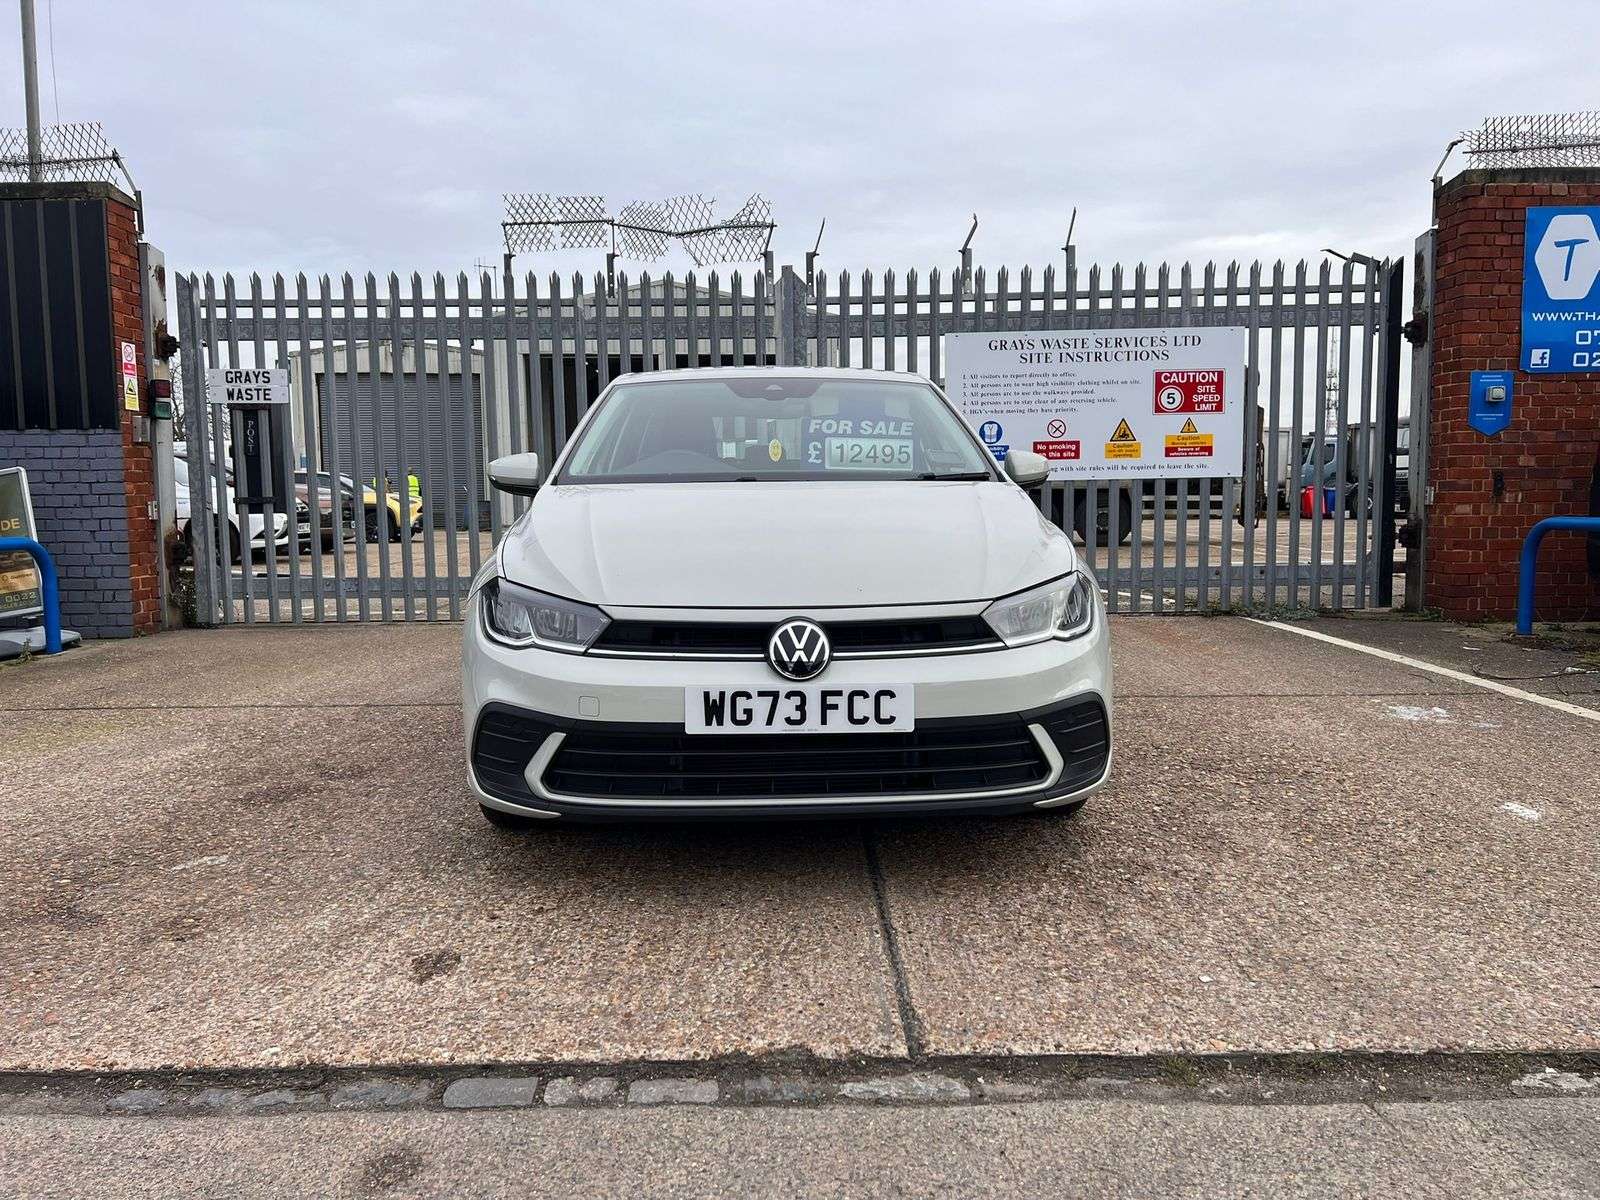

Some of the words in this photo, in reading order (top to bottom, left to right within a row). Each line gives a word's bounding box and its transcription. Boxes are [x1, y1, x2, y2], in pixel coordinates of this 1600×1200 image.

[1554, 238, 1589, 282] T
[1041, 337, 1090, 350] WASTE
[1094, 336, 1168, 349] SERVICES
[1173, 335, 1202, 347] LTD
[1019, 352, 1053, 364] SITE
[1059, 350, 1170, 363] INSTRUCTIONS
[225, 371, 271, 384] GRAYS
[1161, 372, 1218, 383] CAUTION
[226, 388, 272, 401] WASTE
[1197, 385, 1216, 393] SITE
[1166, 392, 1176, 405] 5
[1192, 394, 1221, 402] SPEED
[1195, 403, 1217, 411] LIMIT
[808, 419, 853, 434] FOR
[859, 421, 914, 436] SALE
[808, 441, 823, 464] £
[835, 443, 911, 464] 12495
[703, 690, 807, 727] WG73
[820, 689, 897, 726] FCC
